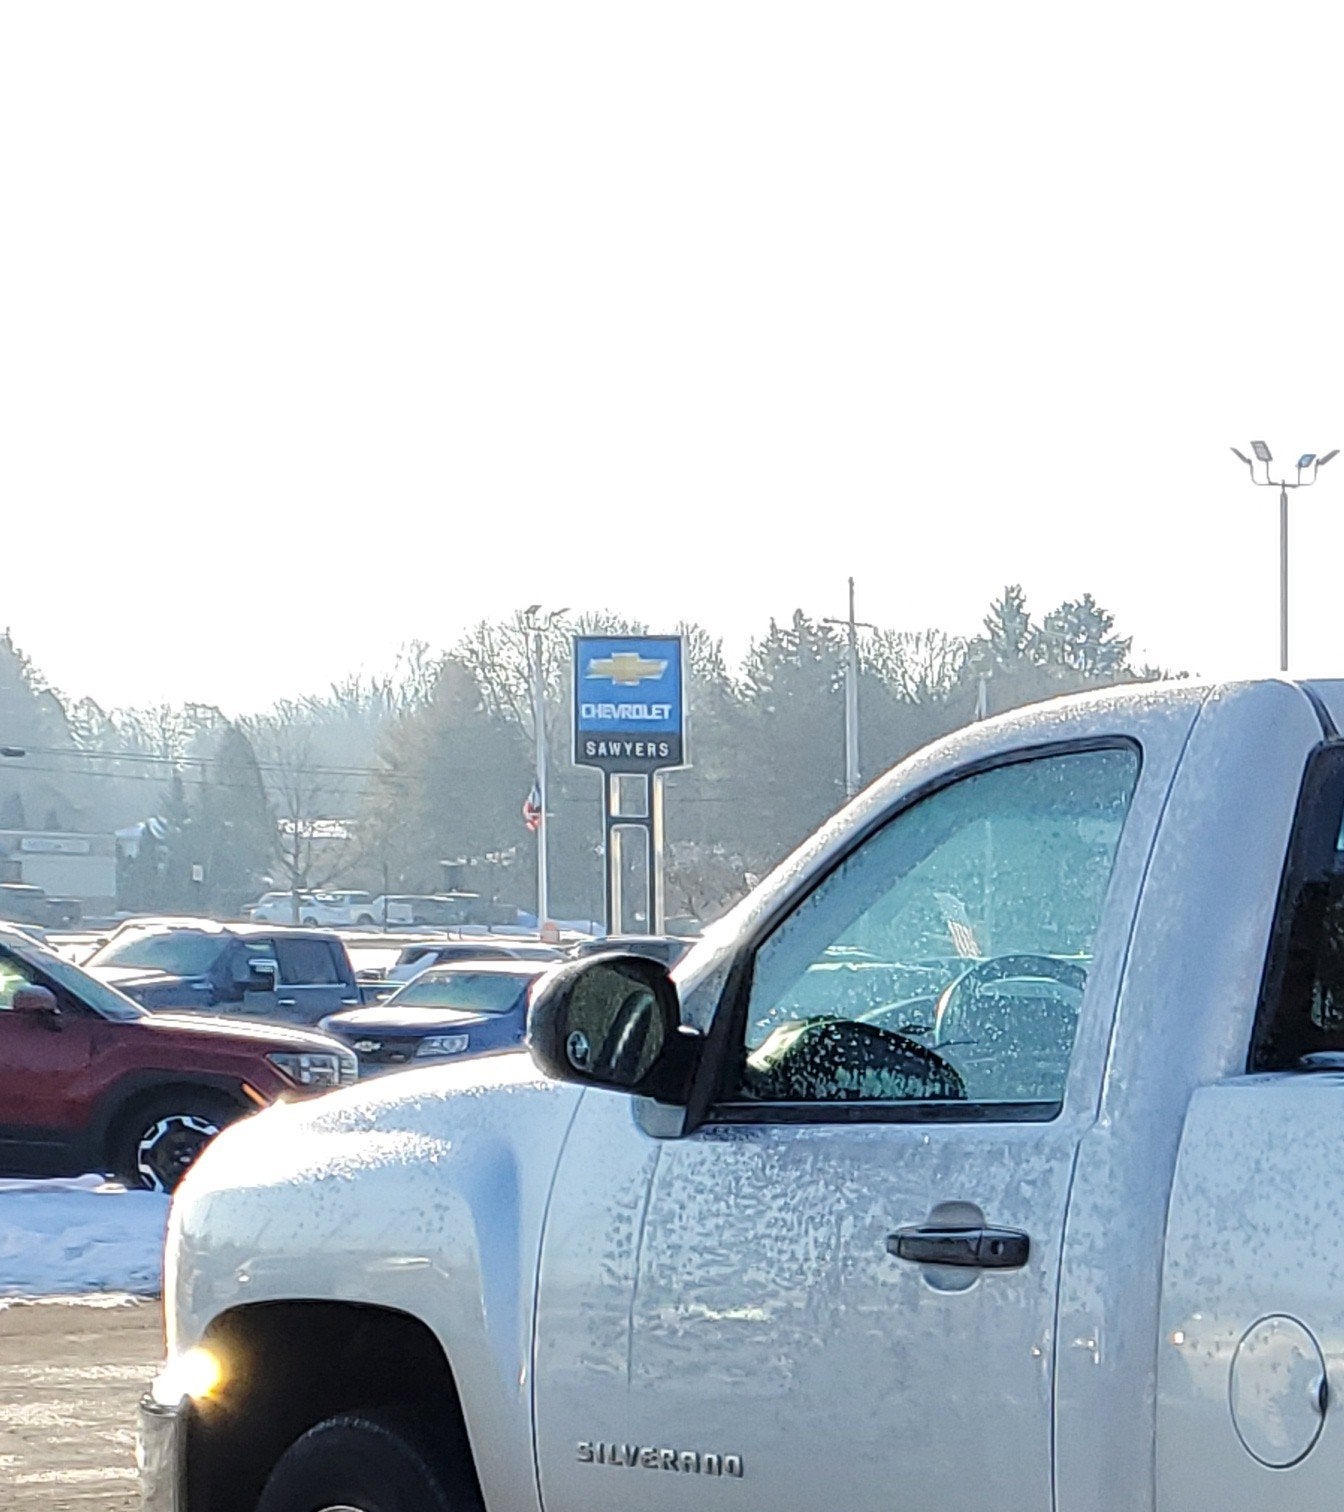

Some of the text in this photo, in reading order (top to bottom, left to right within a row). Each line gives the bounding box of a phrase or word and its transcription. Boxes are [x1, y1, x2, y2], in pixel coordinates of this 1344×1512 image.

[581, 703, 672, 719] CHEVROLET
[586, 741, 669, 757] SAWYERS
[577, 1441, 743, 1477] SILVERADO
